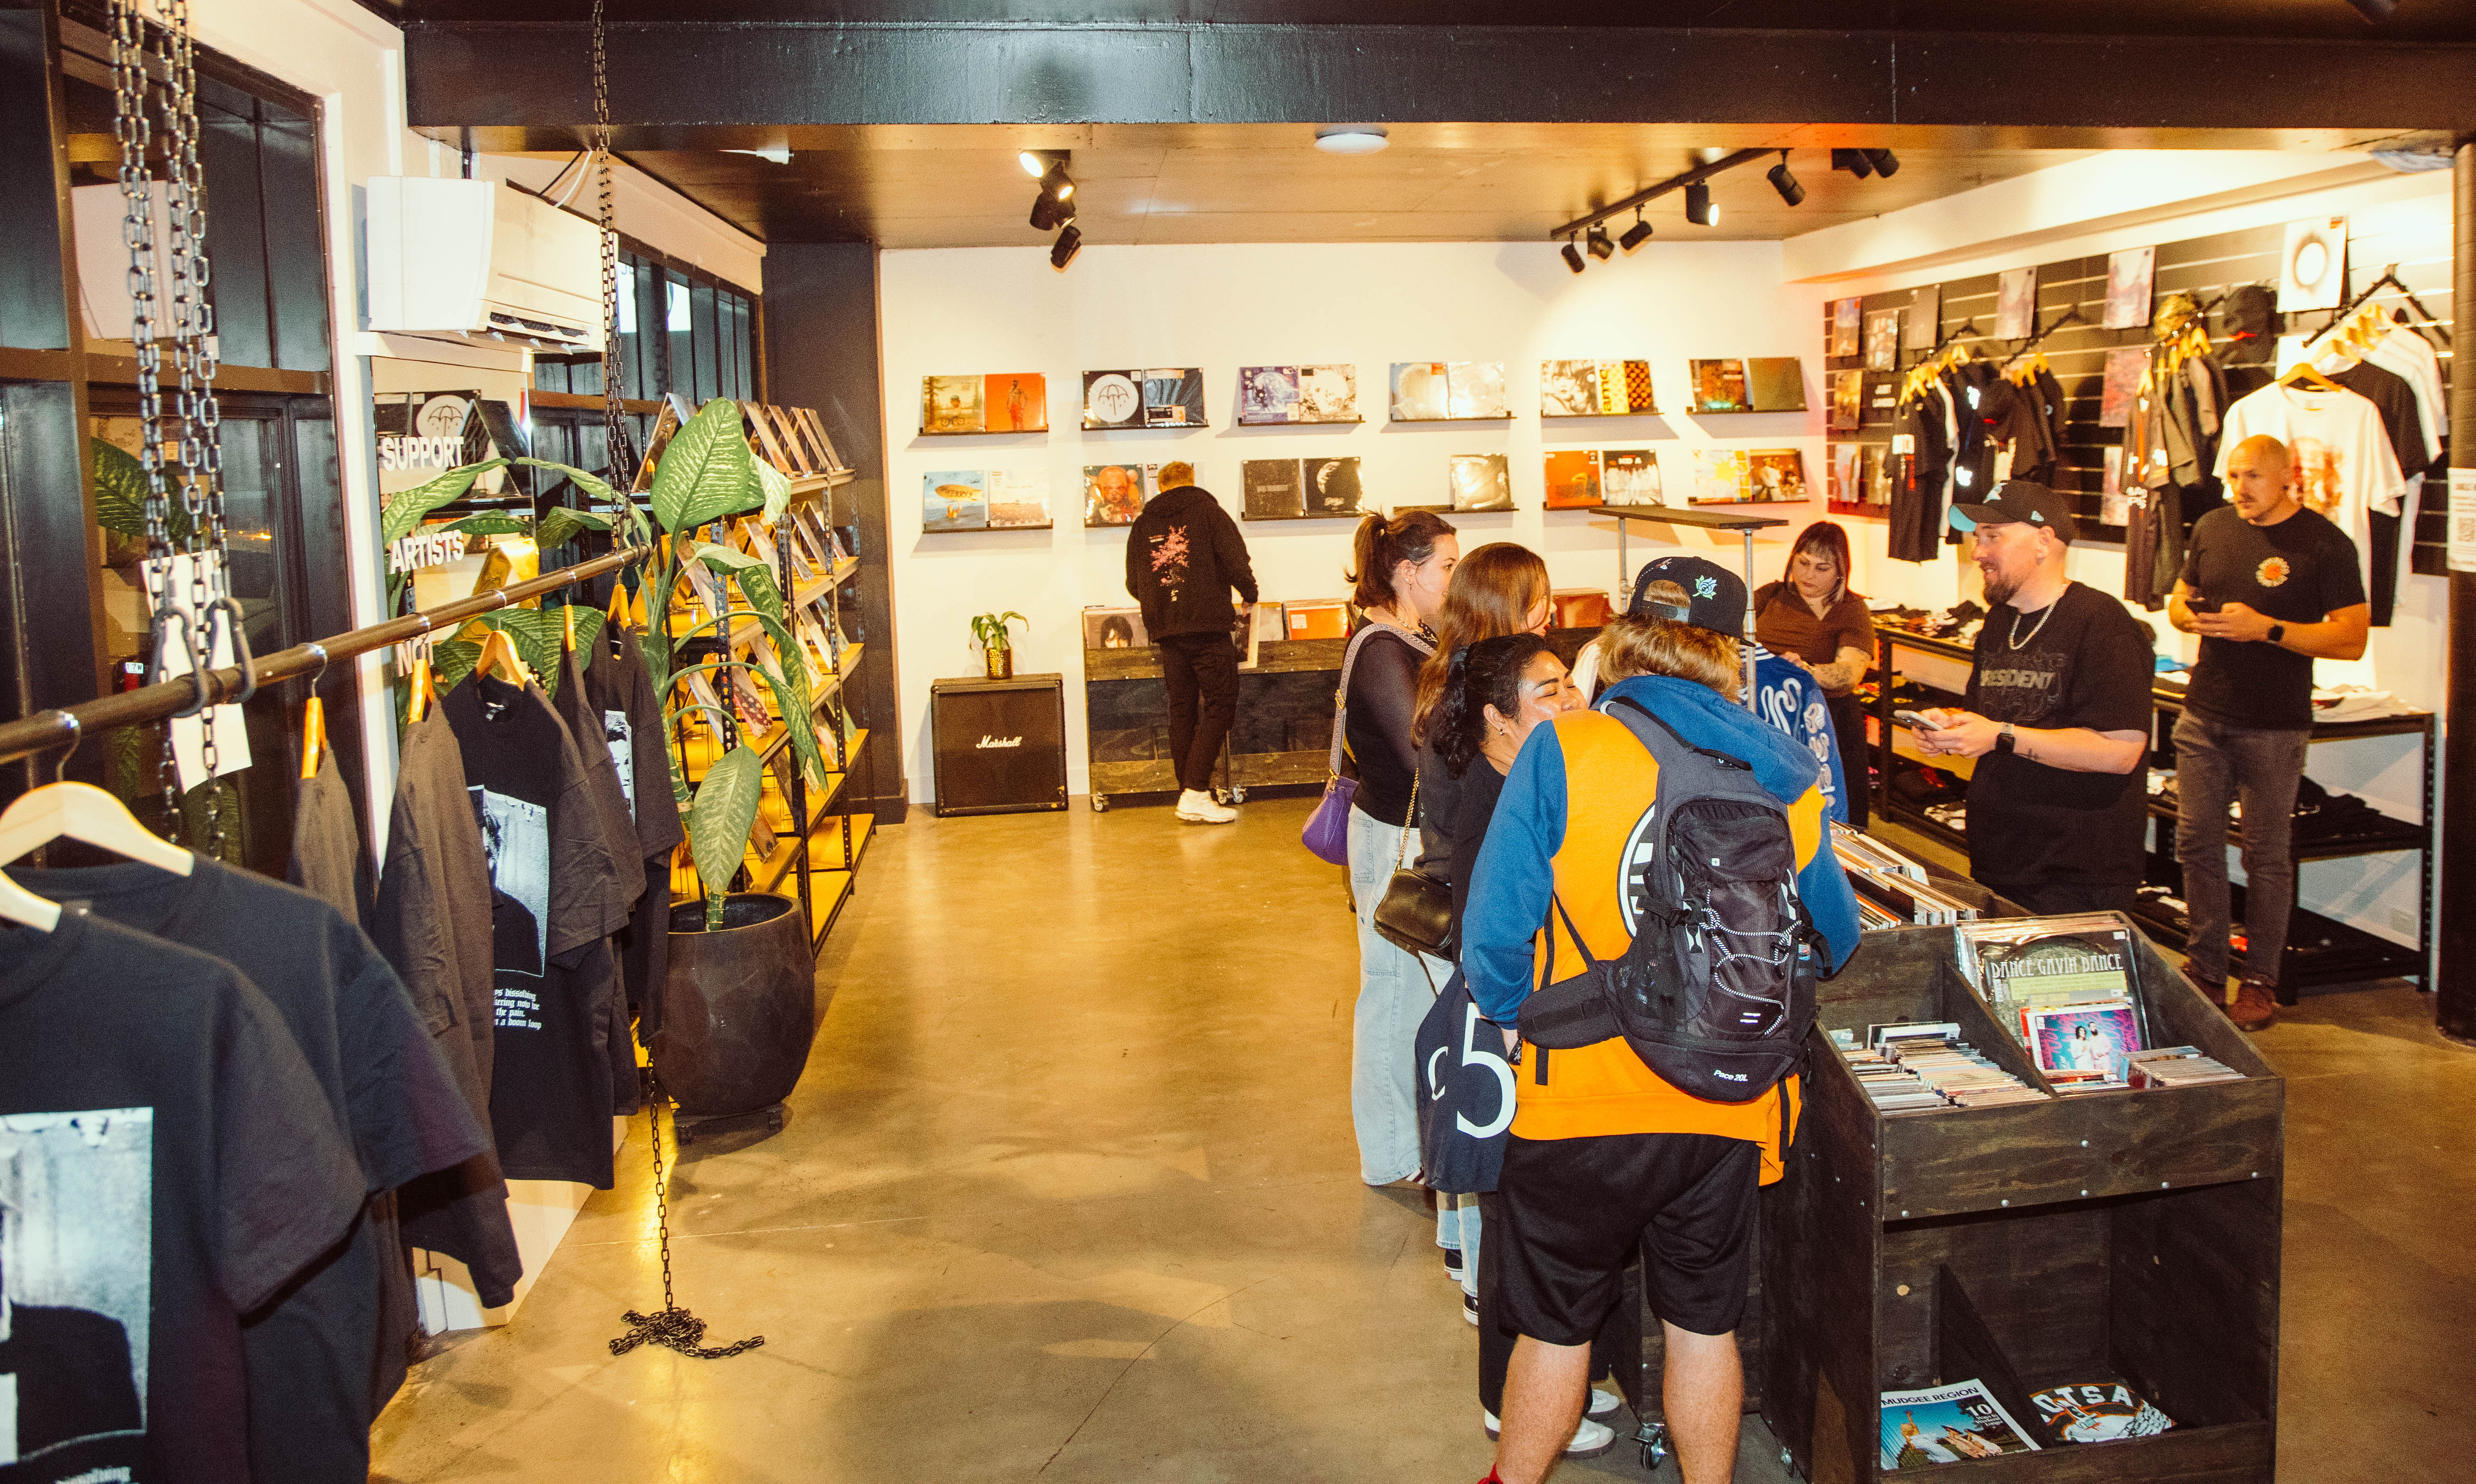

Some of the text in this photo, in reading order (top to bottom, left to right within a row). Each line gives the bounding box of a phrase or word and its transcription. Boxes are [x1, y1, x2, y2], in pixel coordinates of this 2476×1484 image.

[382, 436, 464, 472] SUPPORT
[390, 529, 465, 574] ARTISTS
[975, 735, 1022, 749] Marshall
[1990, 953, 2124, 978] DANCE GAVIN DANCE
[504, 988, 537, 1002] dissolving
[517, 1000, 531, 1008] now
[496, 1007, 526, 1017] the pain.
[508, 1018, 527, 1027] doom
[528, 1019, 542, 1030] loop
[1714, 1070, 1748, 1082] Pace 20L
[1881, 1386, 1979, 1406] MUDGEE REGION
[1966, 1404, 1992, 1416] 10
